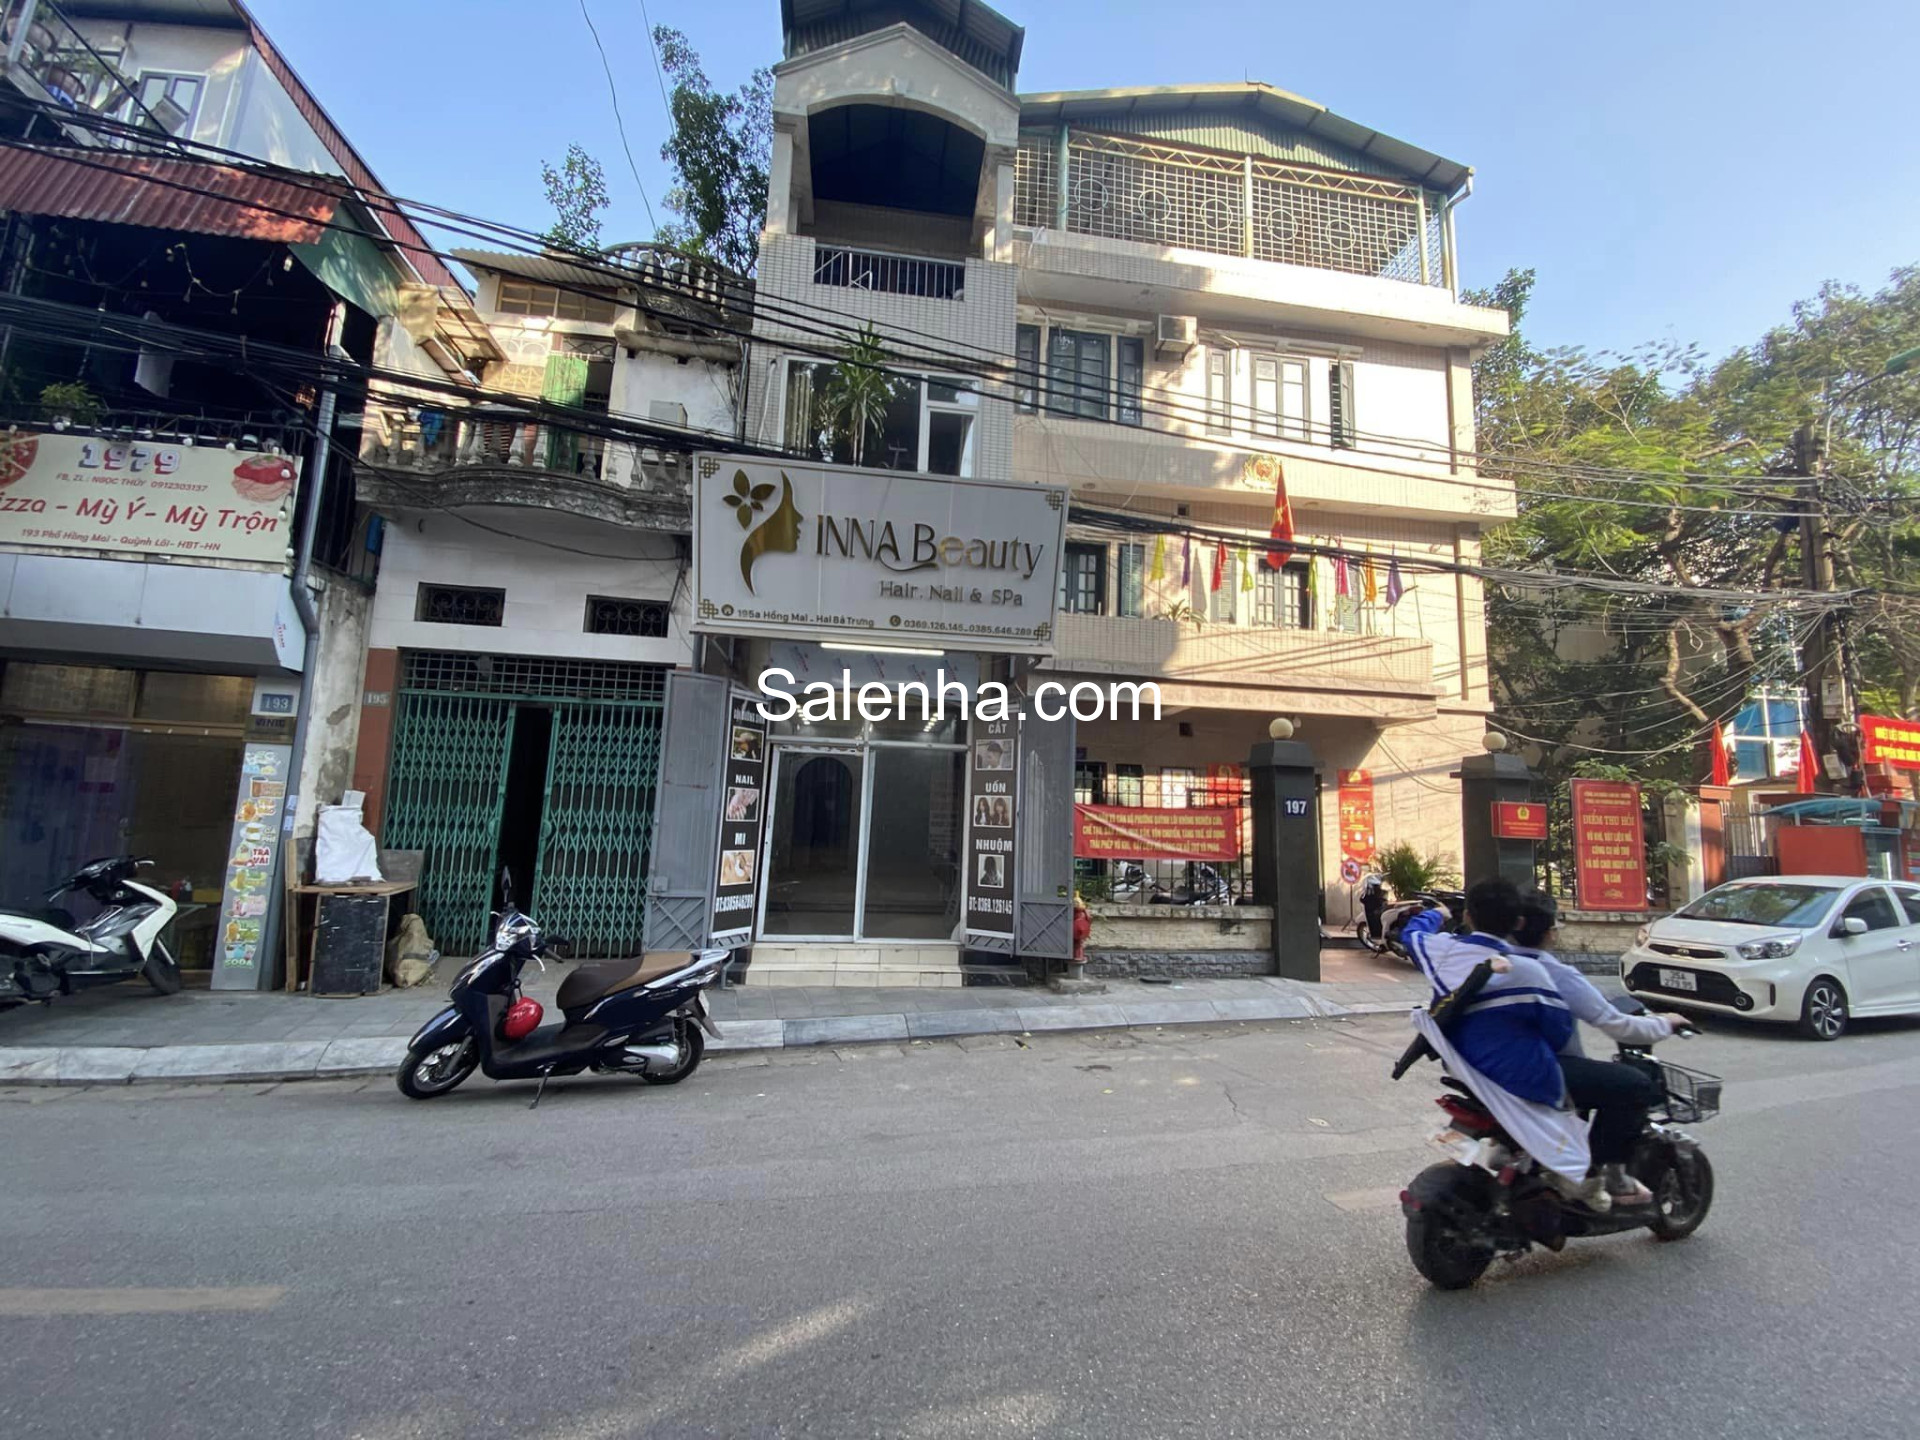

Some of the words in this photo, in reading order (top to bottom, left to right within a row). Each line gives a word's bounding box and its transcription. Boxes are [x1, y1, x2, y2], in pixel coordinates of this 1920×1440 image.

[78, 443, 181, 475] 1979
[76, 498, 119, 525] Mỳ
[165, 504, 208, 532] Mỳ
[218, 509, 278, 535] Trộn
[21, 528, 40, 537] 193
[816, 514, 901, 571] INNA
[912, 523, 1044, 579] Beauty
[929, 584, 963, 602] Nail
[969, 588, 982, 603] &
[265, 698, 289, 709] 193
[367, 692, 388, 704] 195
[735, 774, 755, 785] NAIL
[1285, 800, 1307, 814] 197
[976, 838, 1013, 853] NHUỘM
